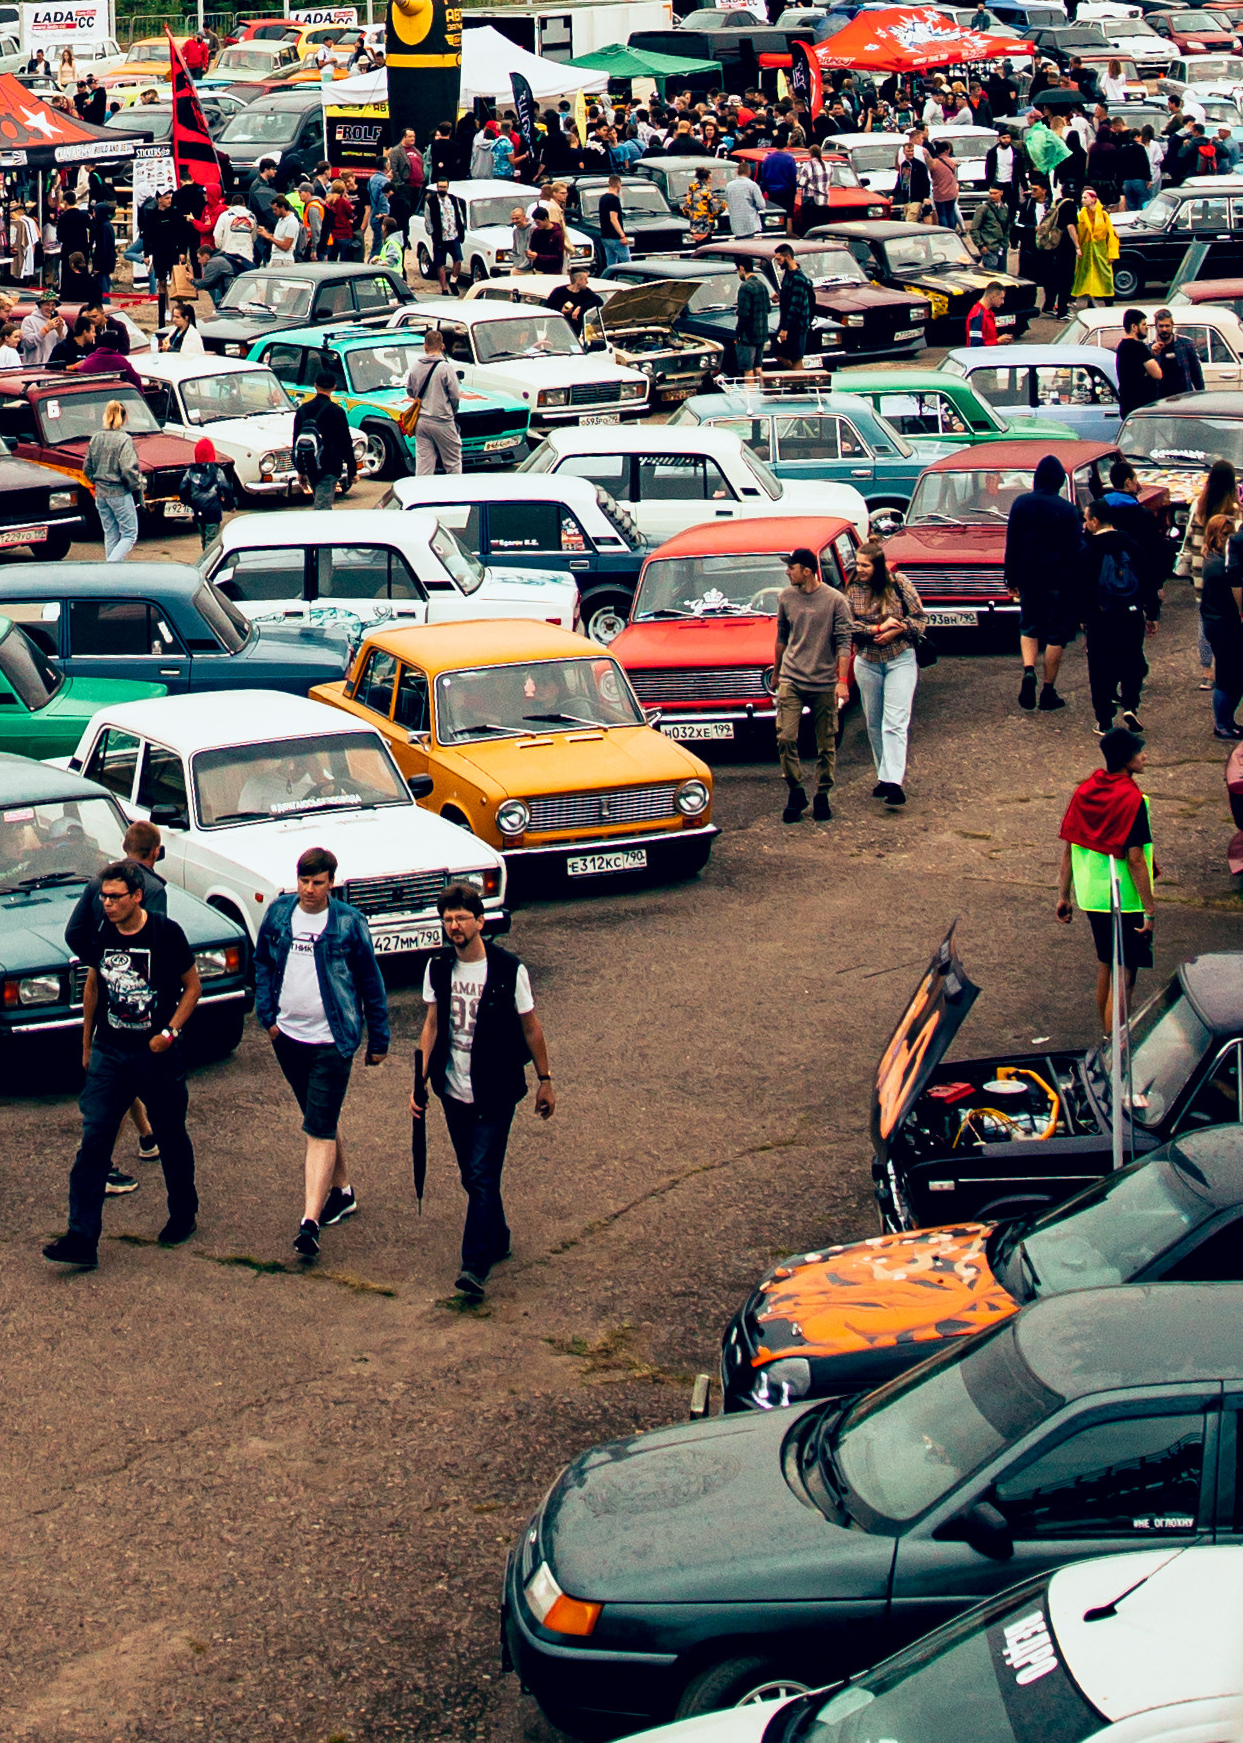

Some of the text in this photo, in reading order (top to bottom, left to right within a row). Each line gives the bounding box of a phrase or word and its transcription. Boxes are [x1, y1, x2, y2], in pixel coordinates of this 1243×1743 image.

[33, 11, 73, 23] LADA
[295, 13, 332, 24] LADA
[341, 125, 383, 140] ROLF
[713, 723, 731, 734] 199
[571, 850, 645, 873] Е312КС 790
[374, 929, 440, 952] 427ММ 790
[1133, 1518, 1194, 1530] #НЕ_ОГЛОХНУ
[1002, 1610, 1059, 1686] ВЕДРО
